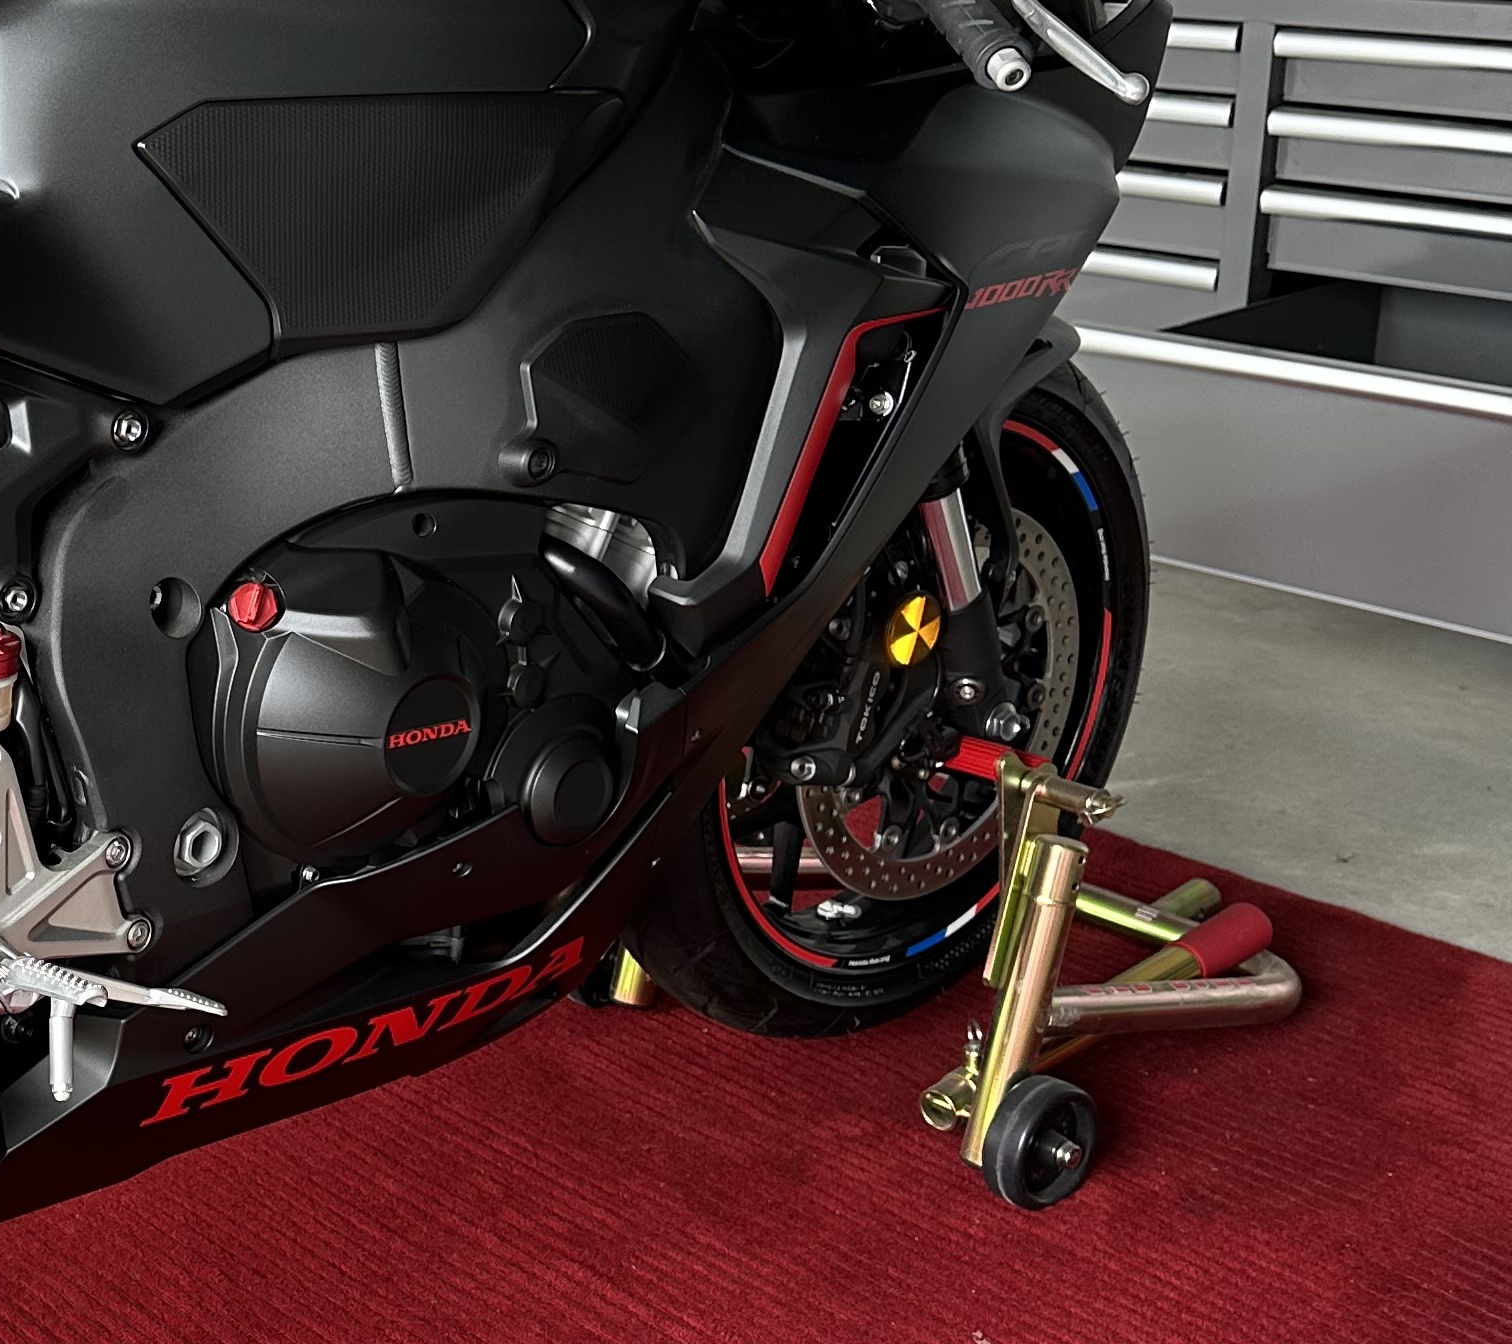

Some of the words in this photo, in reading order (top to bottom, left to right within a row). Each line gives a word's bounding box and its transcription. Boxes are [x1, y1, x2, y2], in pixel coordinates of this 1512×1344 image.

[388, 718, 472, 749] HONDA
[855, 671, 881, 744] TOKICO
[138, 936, 584, 1128] HONDA
